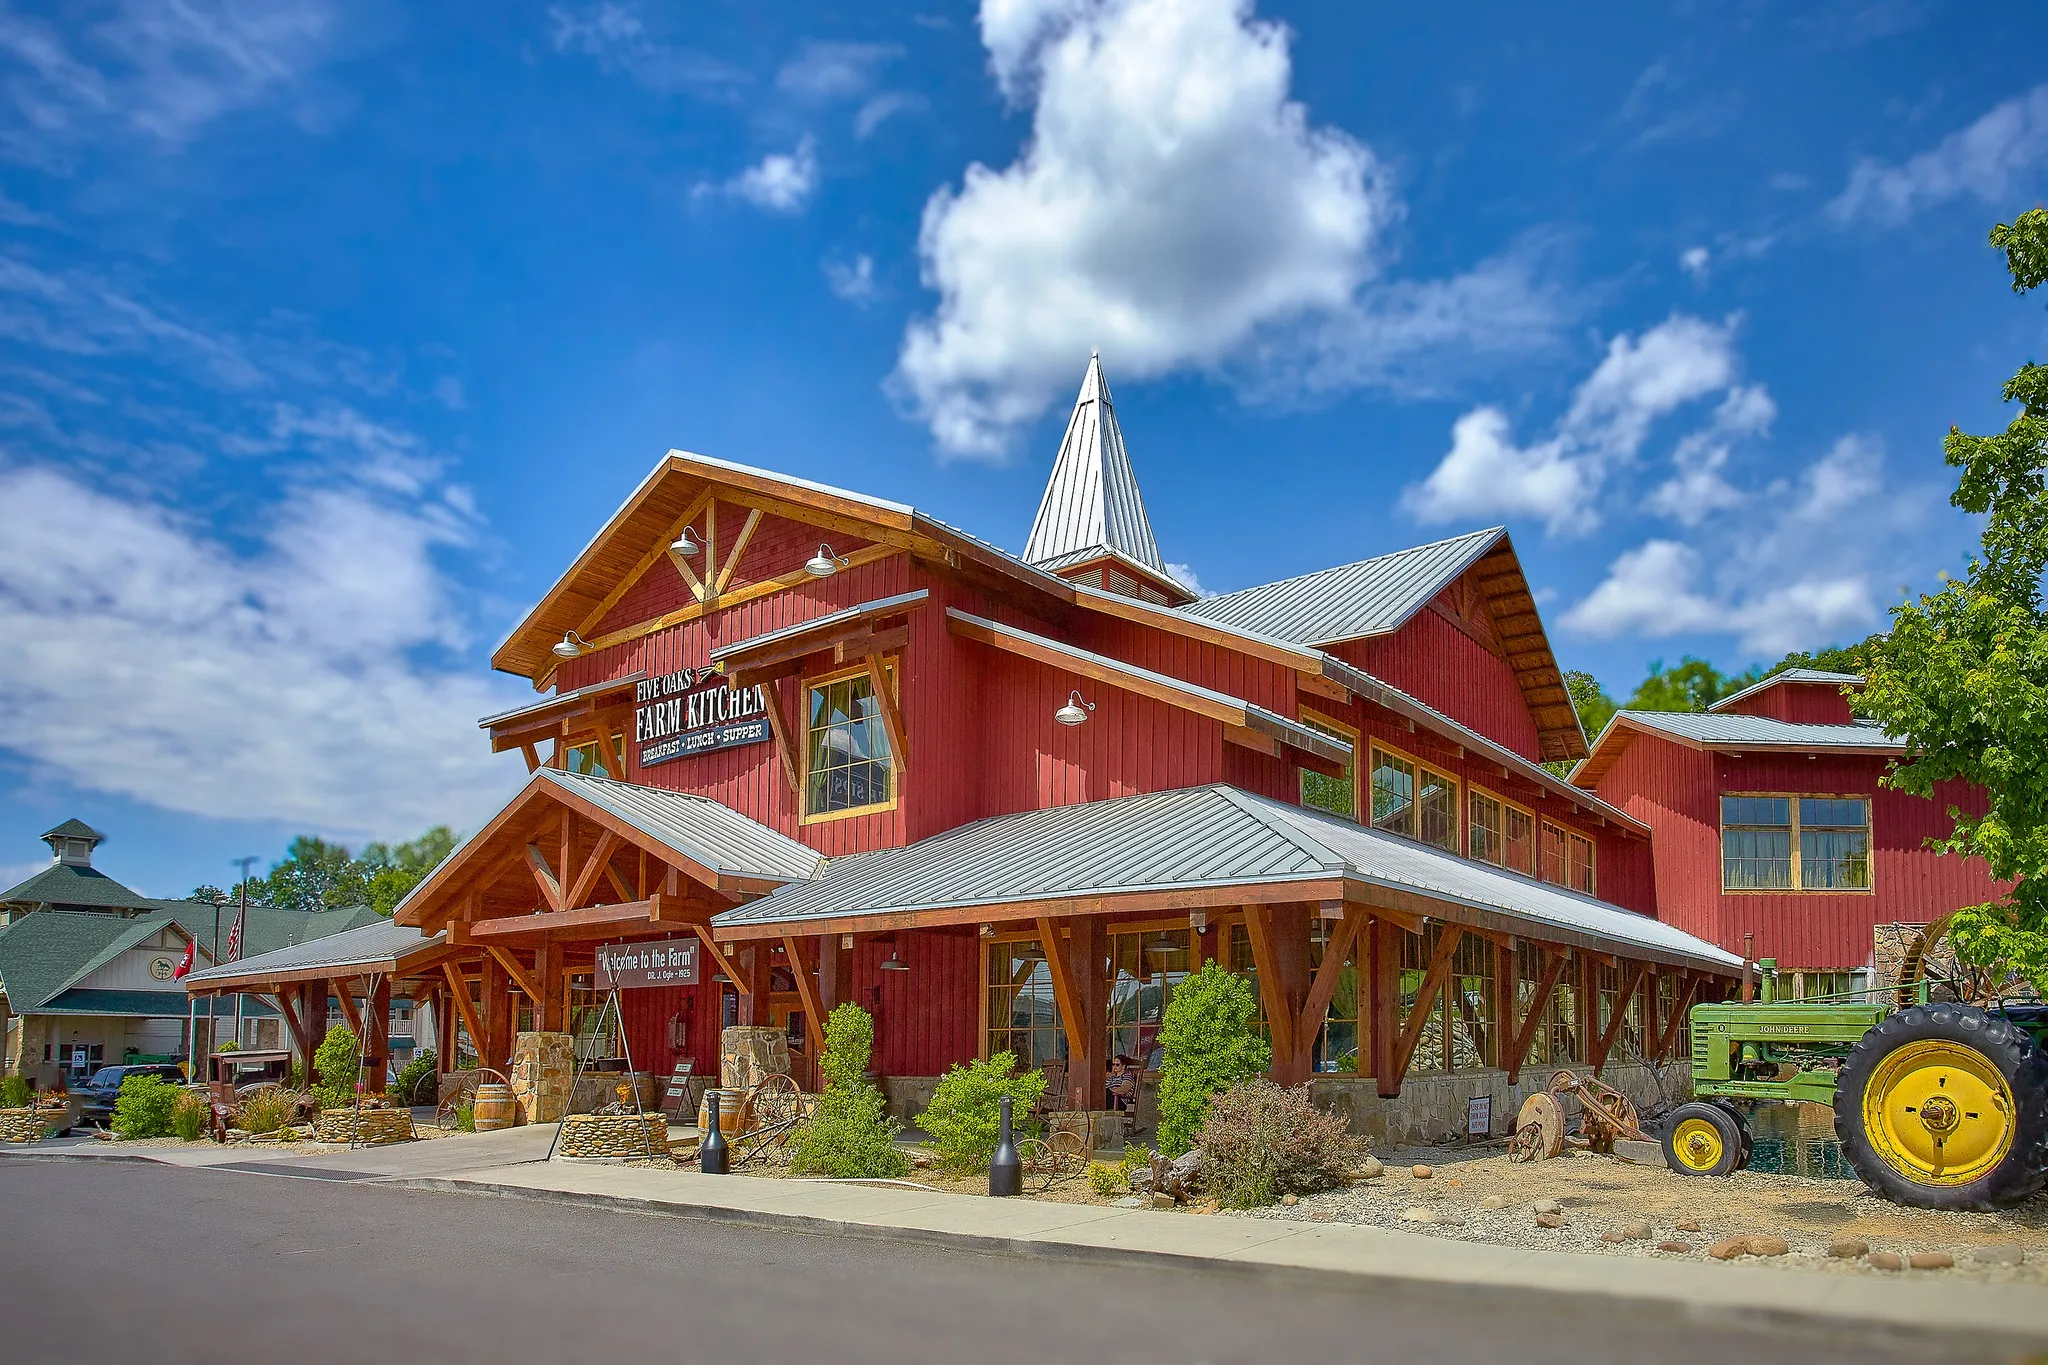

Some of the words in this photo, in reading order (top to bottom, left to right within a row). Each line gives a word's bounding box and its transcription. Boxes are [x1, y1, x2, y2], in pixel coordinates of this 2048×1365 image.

[636, 676, 660, 702] FIVE
[662, 668, 692, 695] OAKS
[635, 698, 682, 743] FARM
[687, 683, 765, 729] KITCHEN
[642, 740, 680, 763] BREAKFAST
[686, 731, 715, 750] LUNCH
[723, 723, 763, 743] SUPPER
[641, 950, 649, 969] to
[651, 949, 666, 968] the
[668, 946, 695, 966] Farm"
[678, 969, 691, 978] 1925
[1760, 1025, 1781, 1033] JOHN
[1783, 1025, 1810, 1033] DEERE
